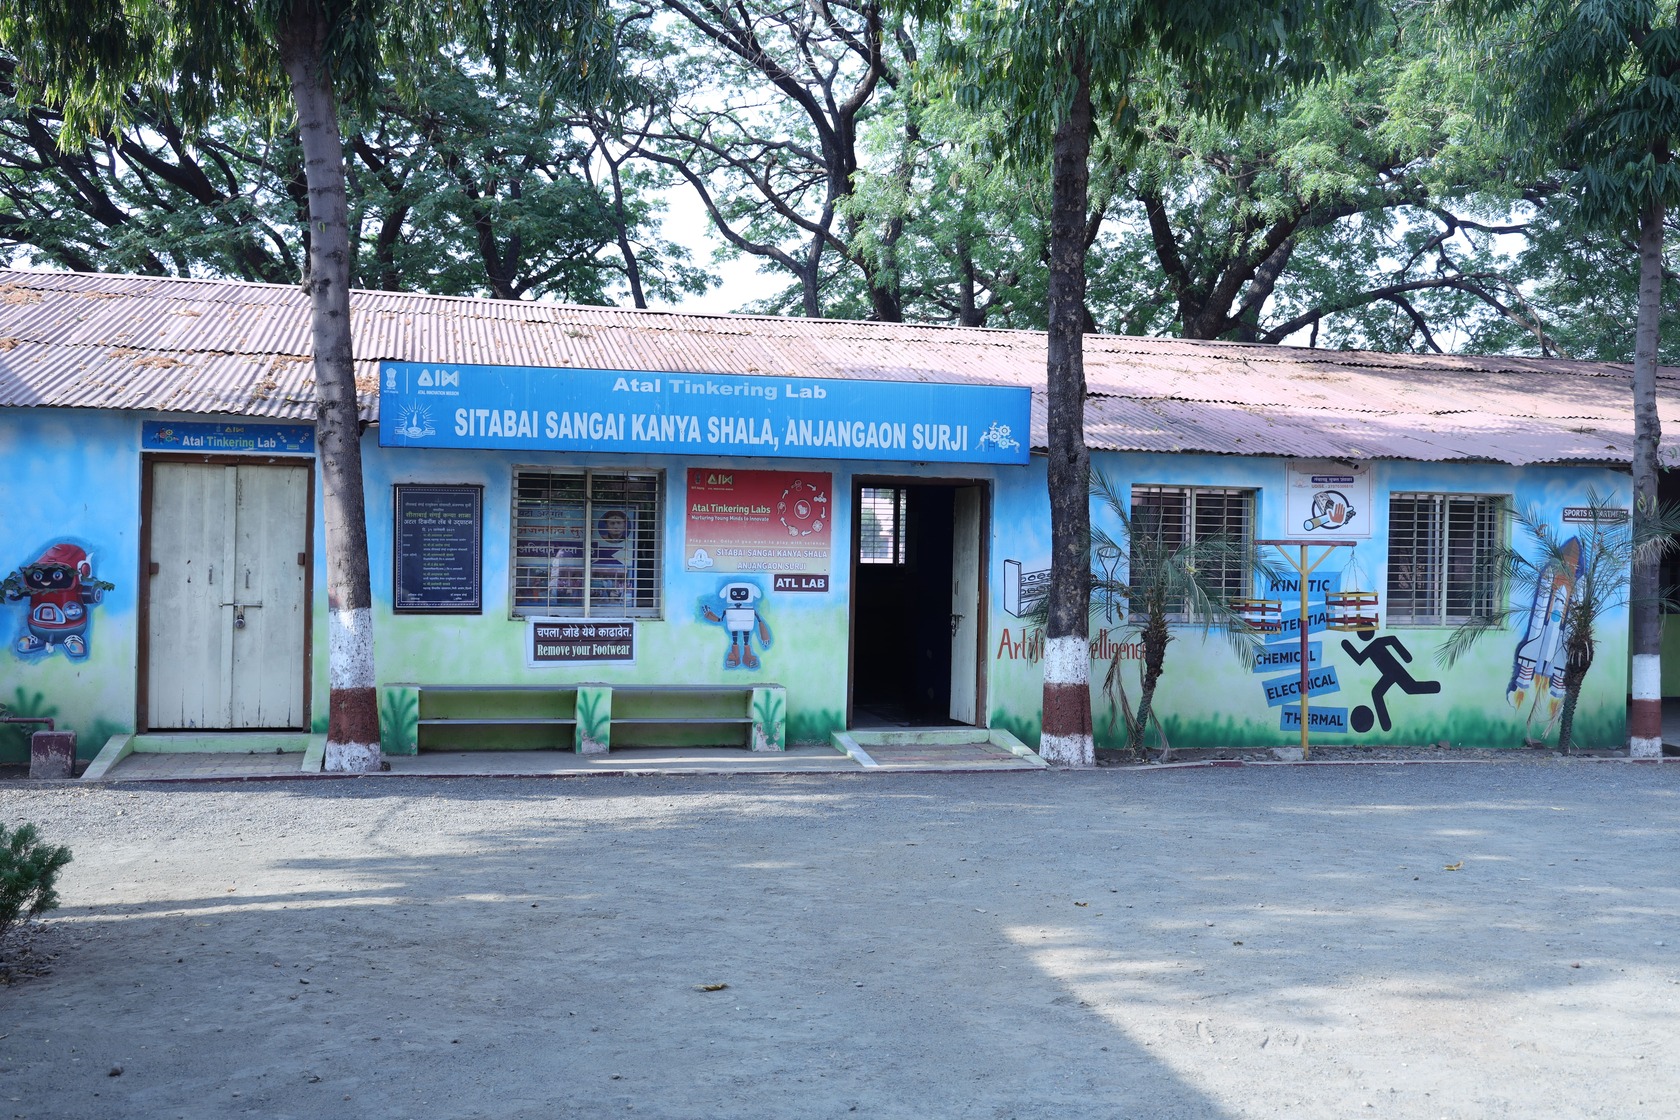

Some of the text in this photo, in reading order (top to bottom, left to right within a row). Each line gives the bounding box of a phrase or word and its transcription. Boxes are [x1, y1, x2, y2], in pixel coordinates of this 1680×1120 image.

[612, 377, 827, 400] Atal Tinkering Lab
[454, 408, 968, 451] SITABAI SANGAI KANYA SHALA, ANJANGAON SURJI
[182, 435, 276, 449] Atal Tinkering Lab
[691, 503, 771, 515] Atal Tinkering Labs
[1563, 508, 1628, 519] SPORTS DPARTMET
[691, 514, 714, 522] Nurturing
[716, 549, 828, 558] SITABAI SANGAI KANYA SHALA
[737, 562, 806, 570] ANJANGAON SURJI
[776, 578, 826, 588] ATL LAB
[1270, 579, 1330, 592] KINTIC
[582, 625, 596, 637] येथे
[598, 625, 632, 638] काढावेत.
[537, 644, 631, 657] Remove your Footwear
[1256, 650, 1316, 665] CHEMICL
